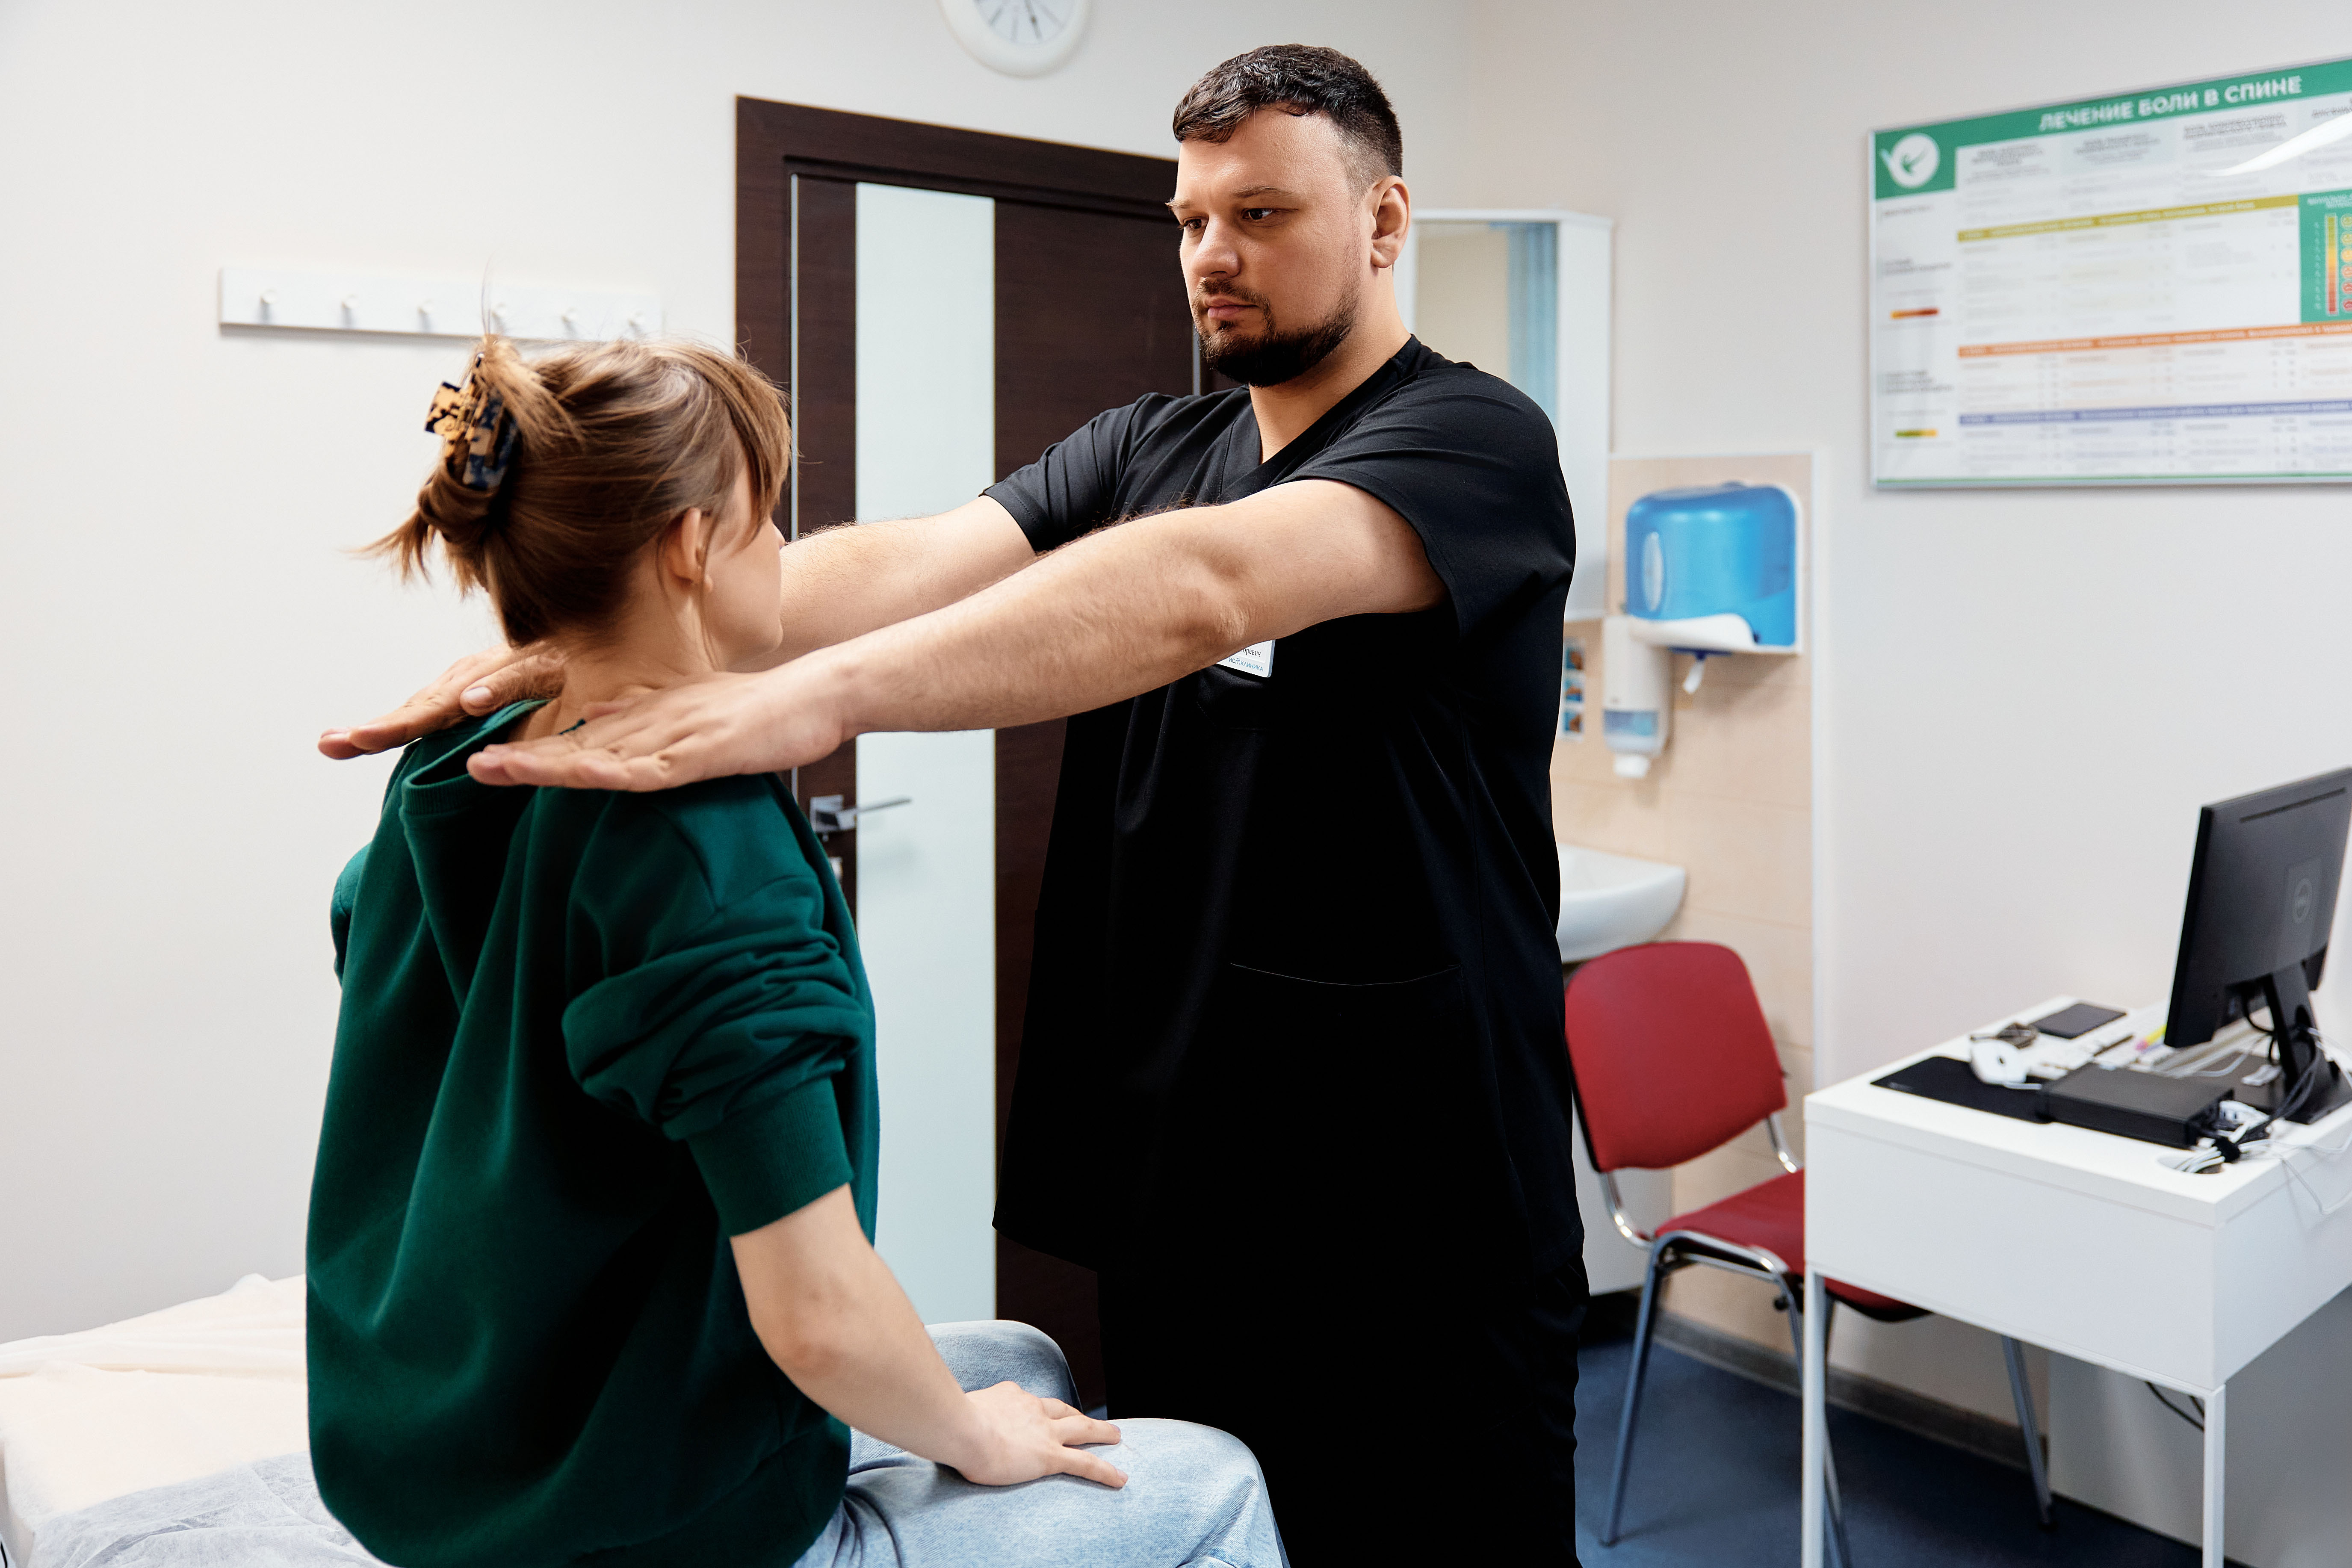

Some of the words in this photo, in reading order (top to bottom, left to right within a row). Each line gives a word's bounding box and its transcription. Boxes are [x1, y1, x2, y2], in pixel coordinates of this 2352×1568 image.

[2039, 101, 2134, 131] ЛЕЧЕНИЕ
[2139, 90, 2198, 117] БОЛИ
[2204, 88, 2219, 107] В
[2225, 75, 2303, 103] СПИНЕ
[1241, 648, 1262, 657] оревич
